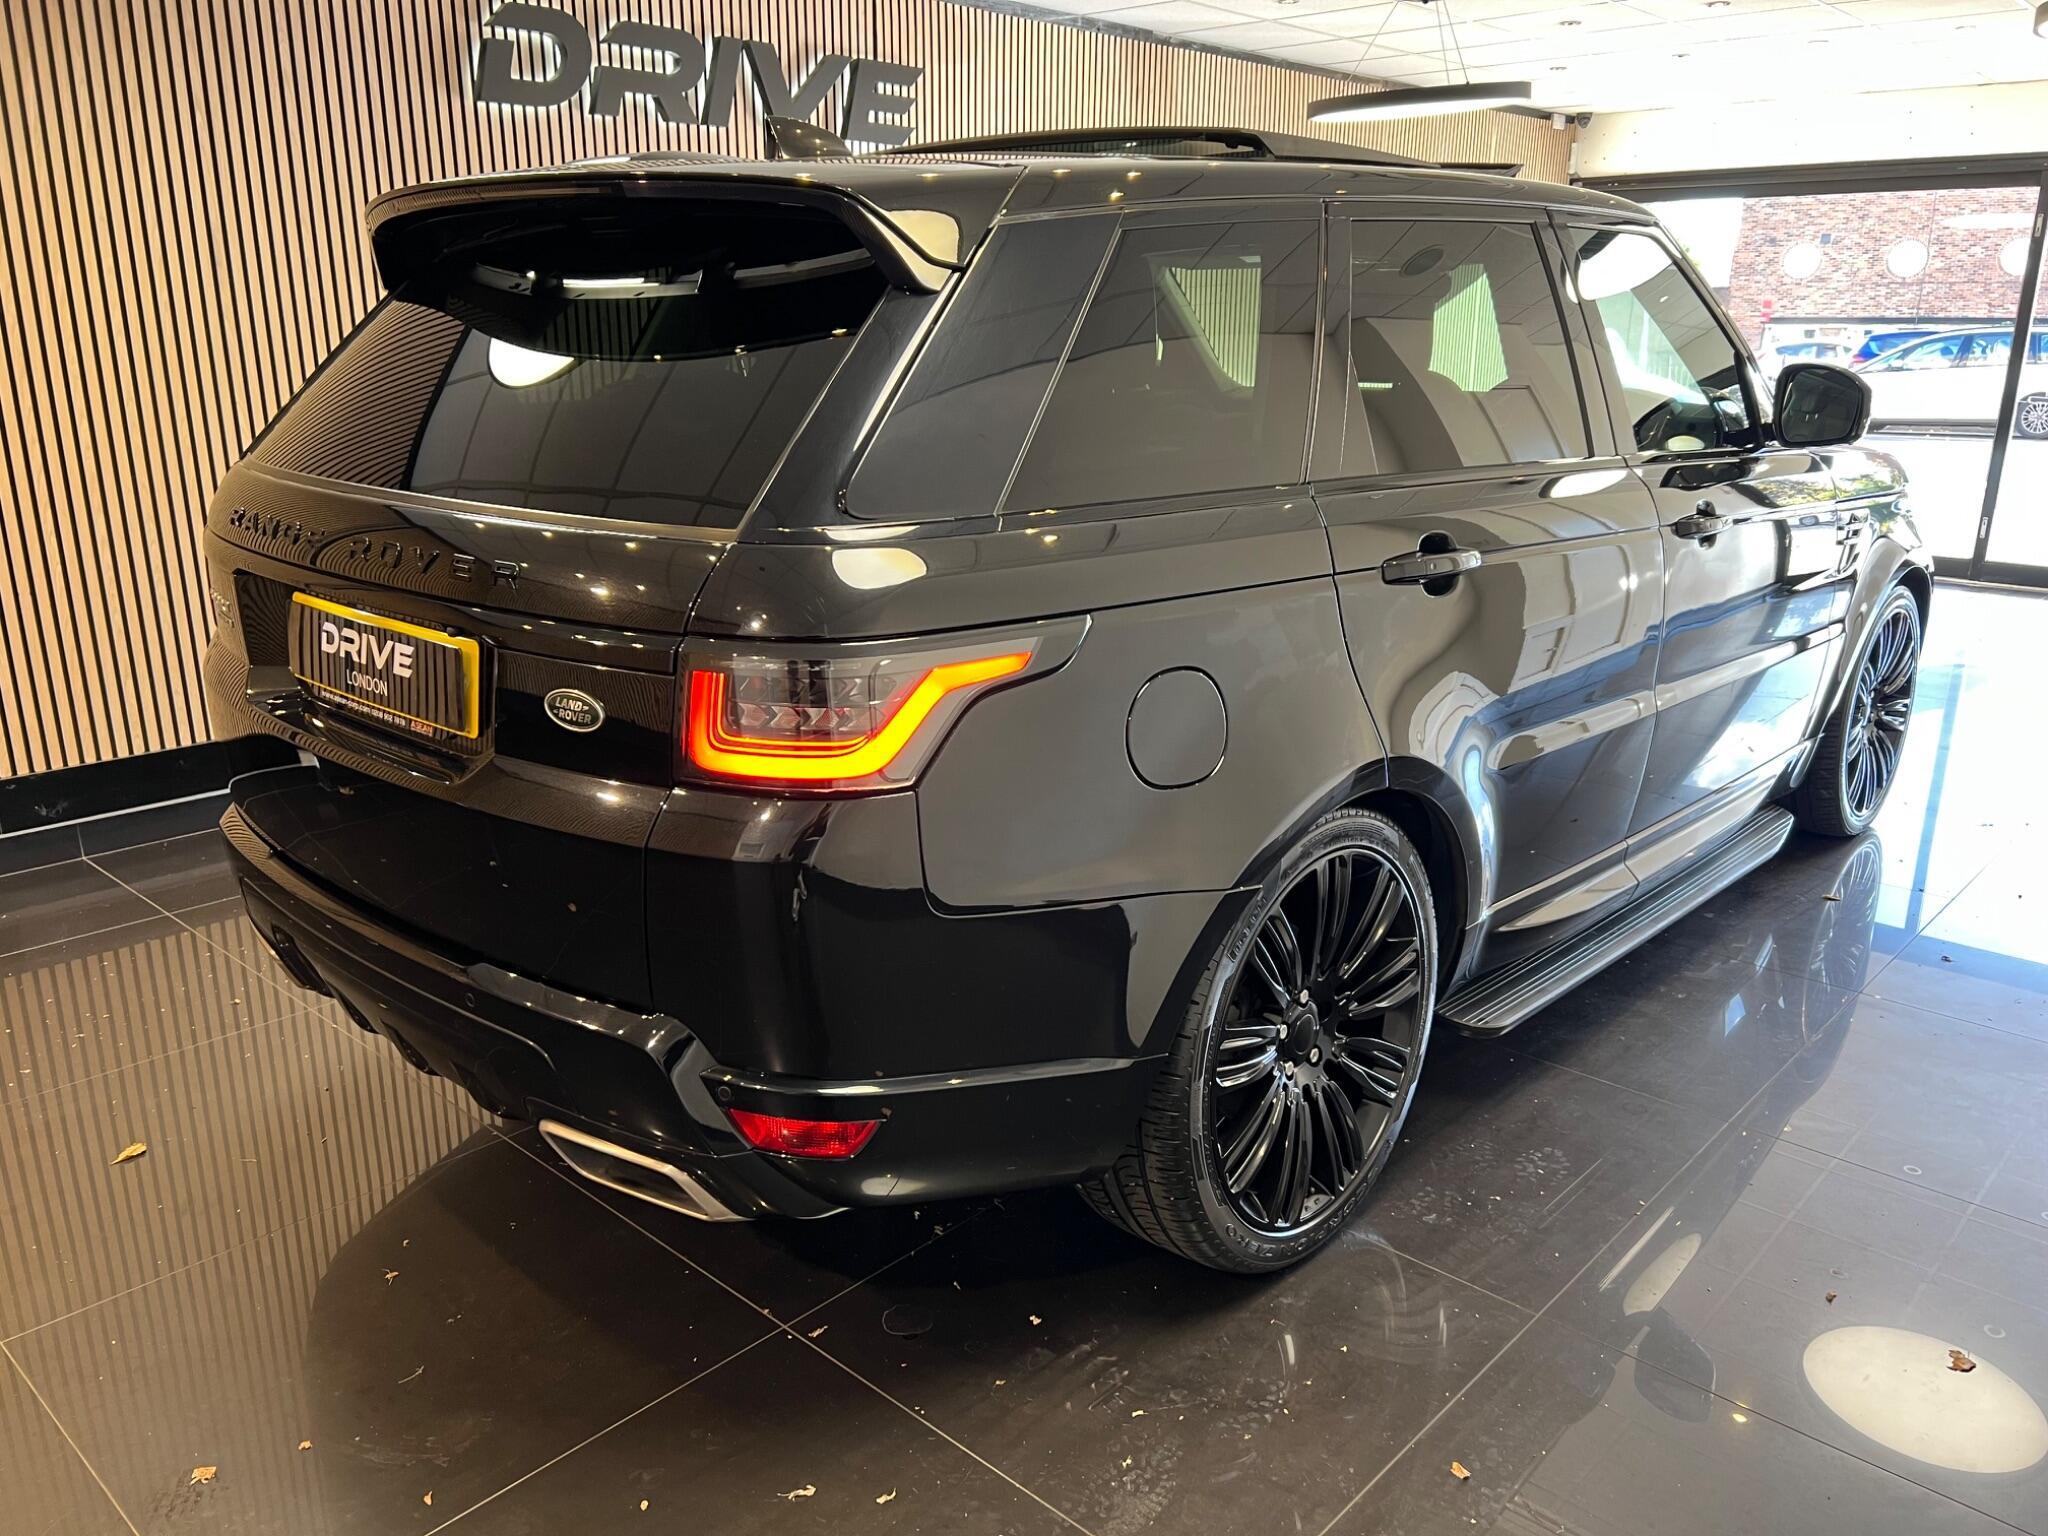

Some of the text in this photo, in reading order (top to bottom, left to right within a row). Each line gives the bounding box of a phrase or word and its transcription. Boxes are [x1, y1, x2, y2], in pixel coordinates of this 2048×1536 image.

[474, 1, 924, 146] DRIVE
[229, 506, 520, 591] RANGE ROVER
[321, 621, 415, 678] DRIVE
[346, 669, 388, 697] LONDON
[555, 696, 583, 712] LAND
[558, 708, 592, 725] ROVER
